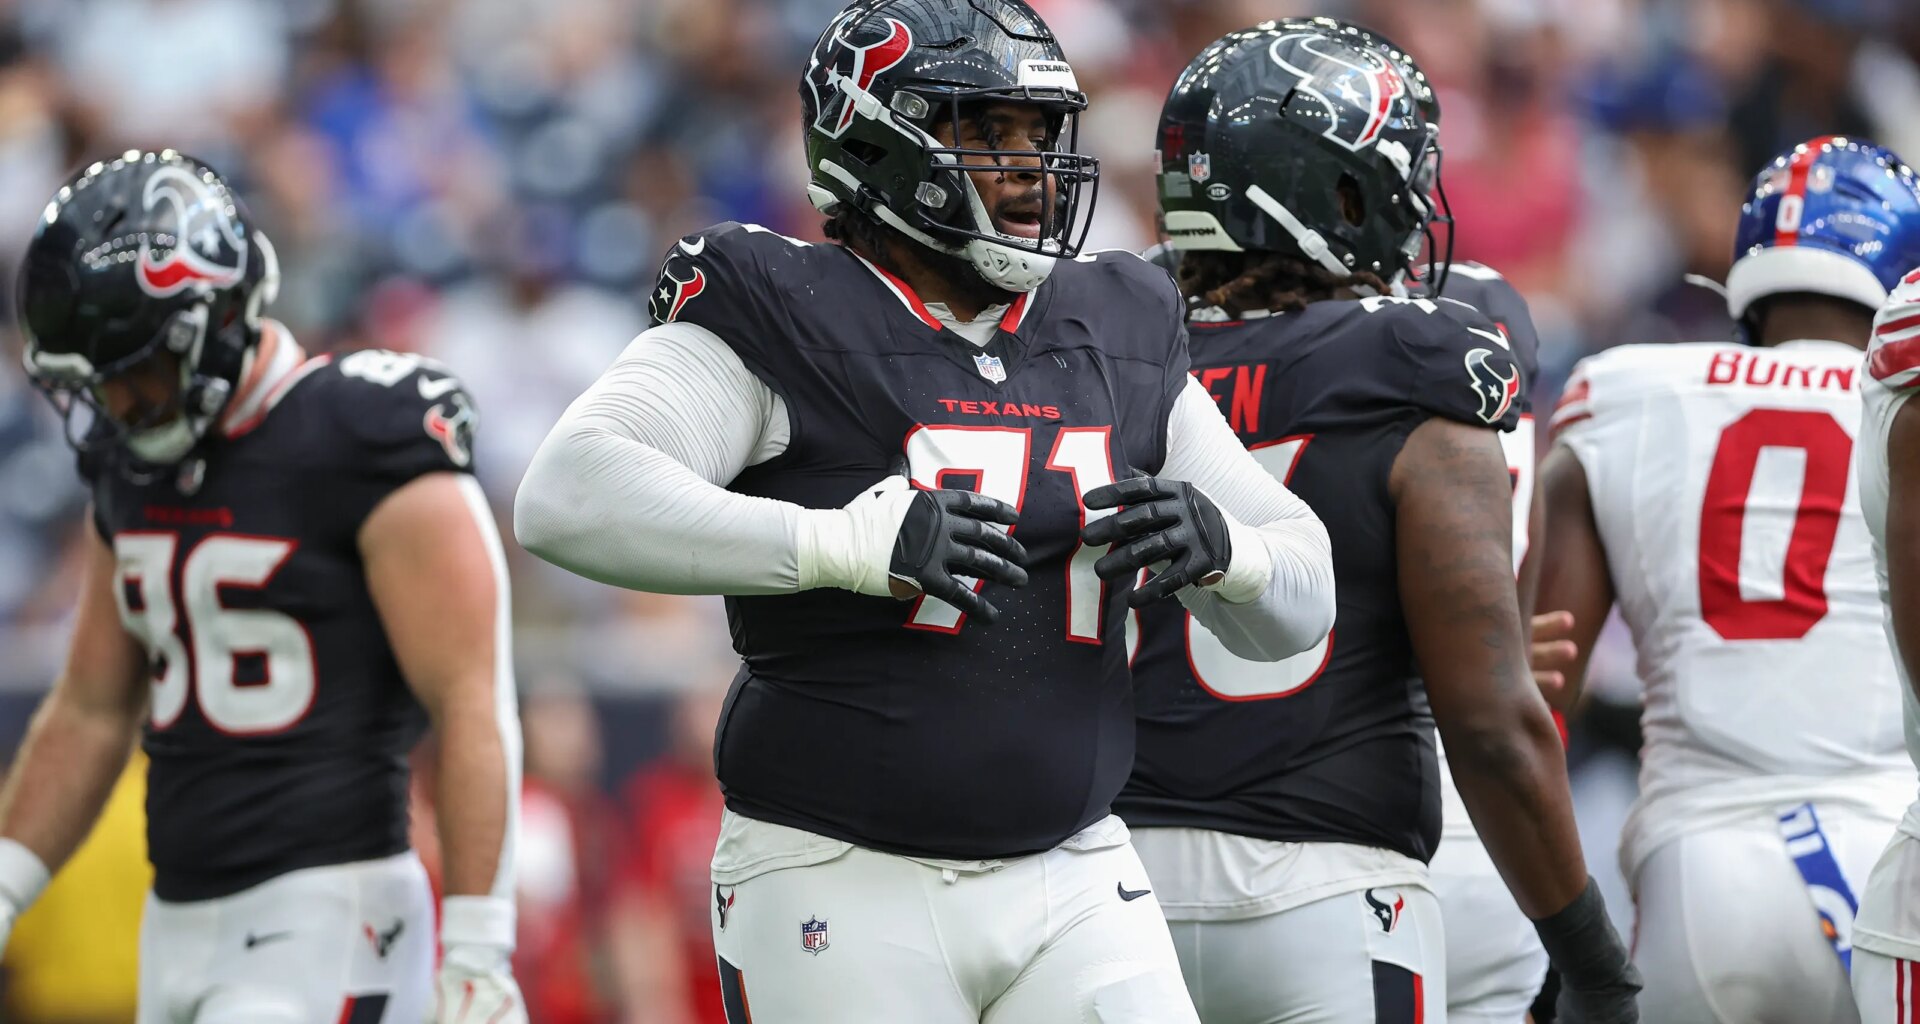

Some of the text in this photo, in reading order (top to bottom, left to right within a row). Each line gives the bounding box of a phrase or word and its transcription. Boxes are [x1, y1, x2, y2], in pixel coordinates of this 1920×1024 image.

[1776, 194, 1804, 233] 0
[1707, 351, 1862, 391] BURN
[937, 399, 1061, 419] TEXANS
[903, 422, 1116, 645] 71
[1699, 408, 1853, 640] 0
[113, 528, 320, 738] 86
[805, 933, 825, 948] NFL
